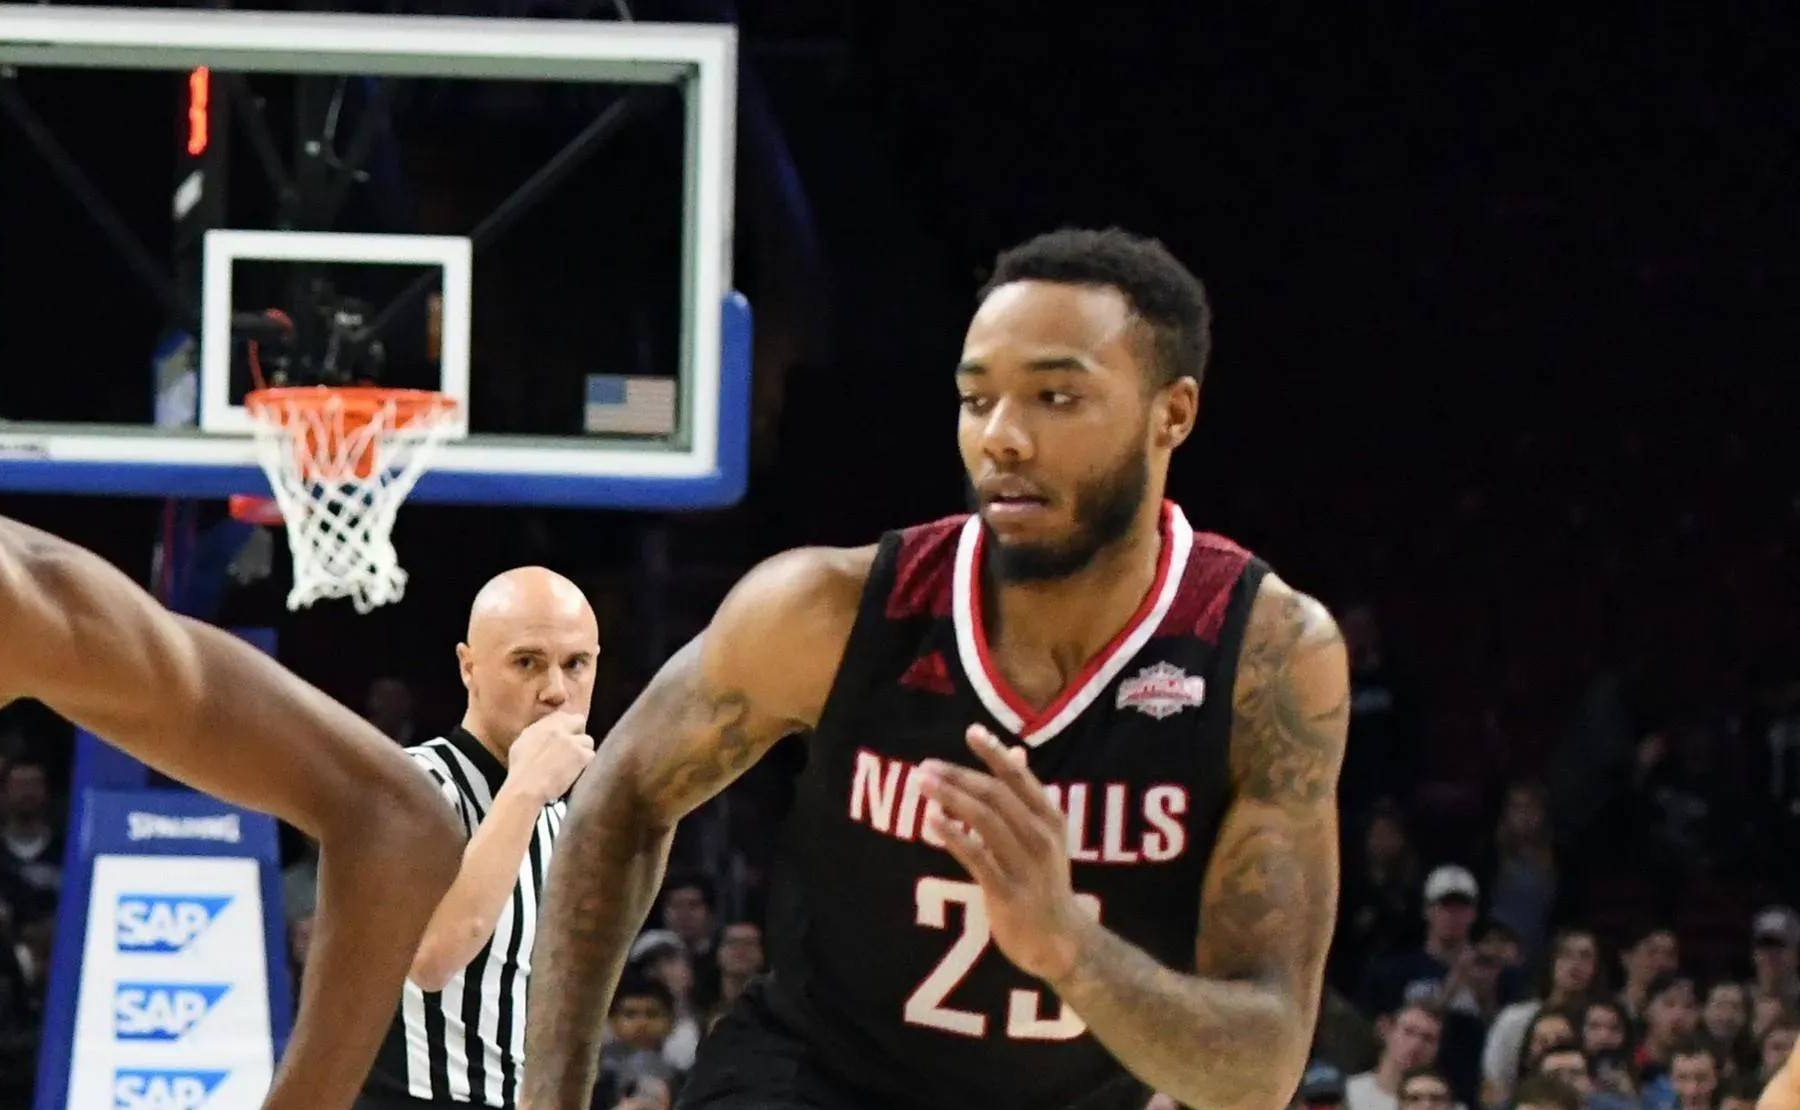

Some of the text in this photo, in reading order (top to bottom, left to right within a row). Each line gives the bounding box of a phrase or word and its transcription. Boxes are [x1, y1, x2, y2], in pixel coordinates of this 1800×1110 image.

[848, 750, 1190, 864] NILLS
[118, 899, 210, 946] SAP
[117, 988, 208, 1034] SAP
